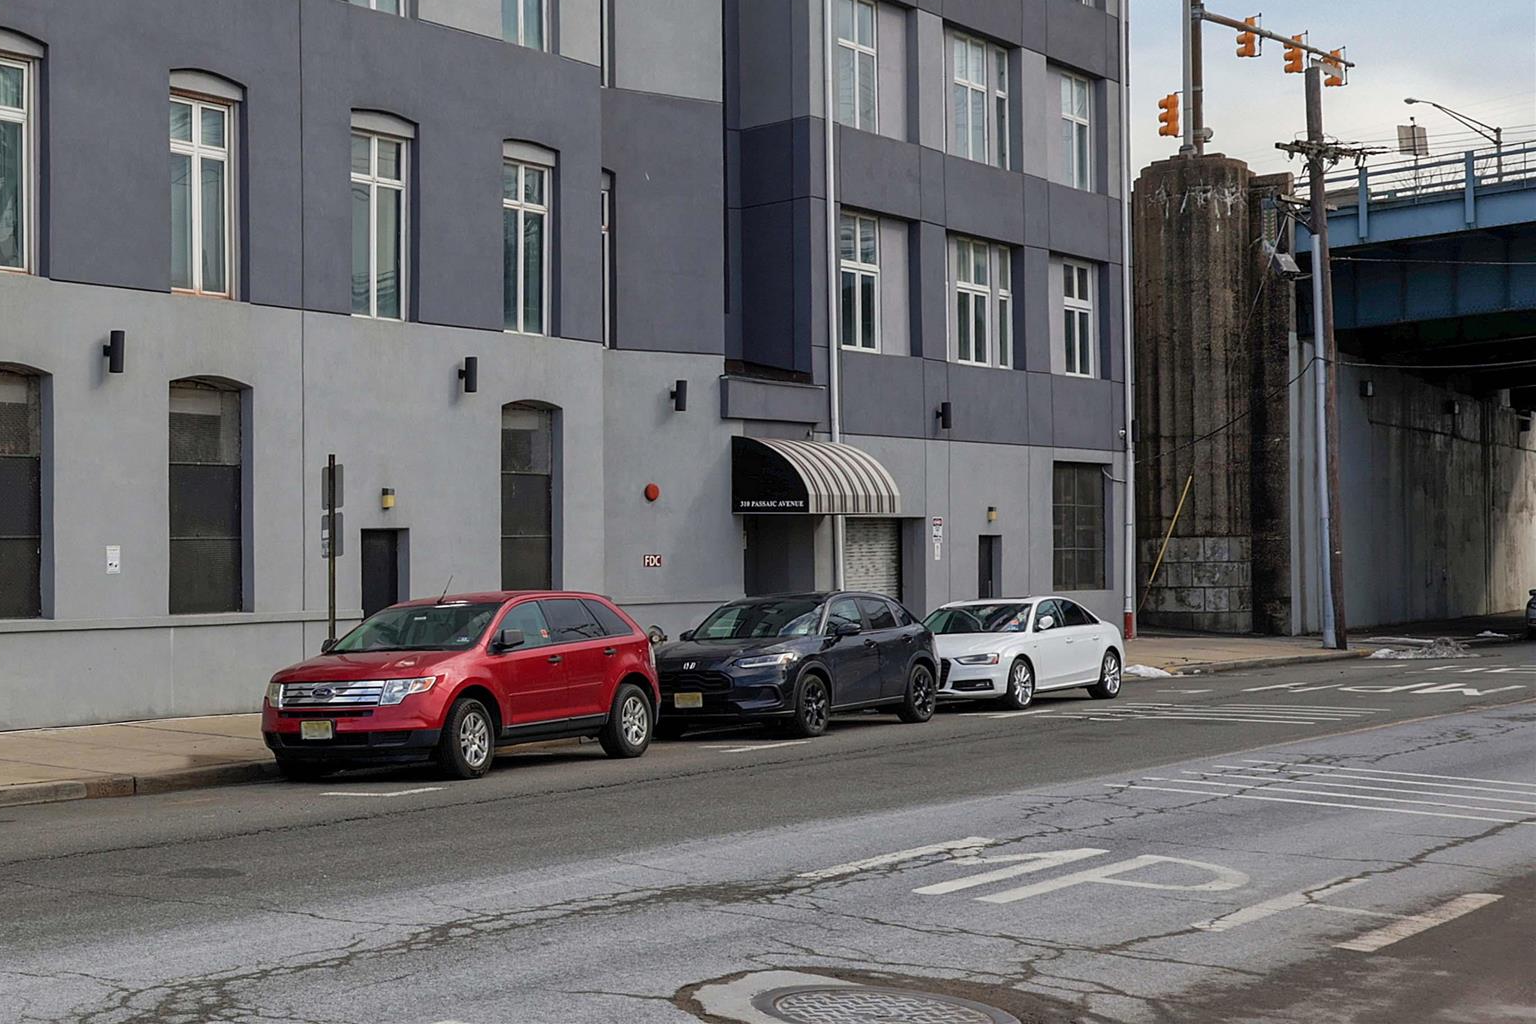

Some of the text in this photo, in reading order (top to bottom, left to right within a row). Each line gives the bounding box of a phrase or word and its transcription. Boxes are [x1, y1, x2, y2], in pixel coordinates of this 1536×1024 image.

[751, 500, 778, 508] PASSAIC
[778, 500, 804, 508] AVENUE
[644, 555, 661, 567] FDC
